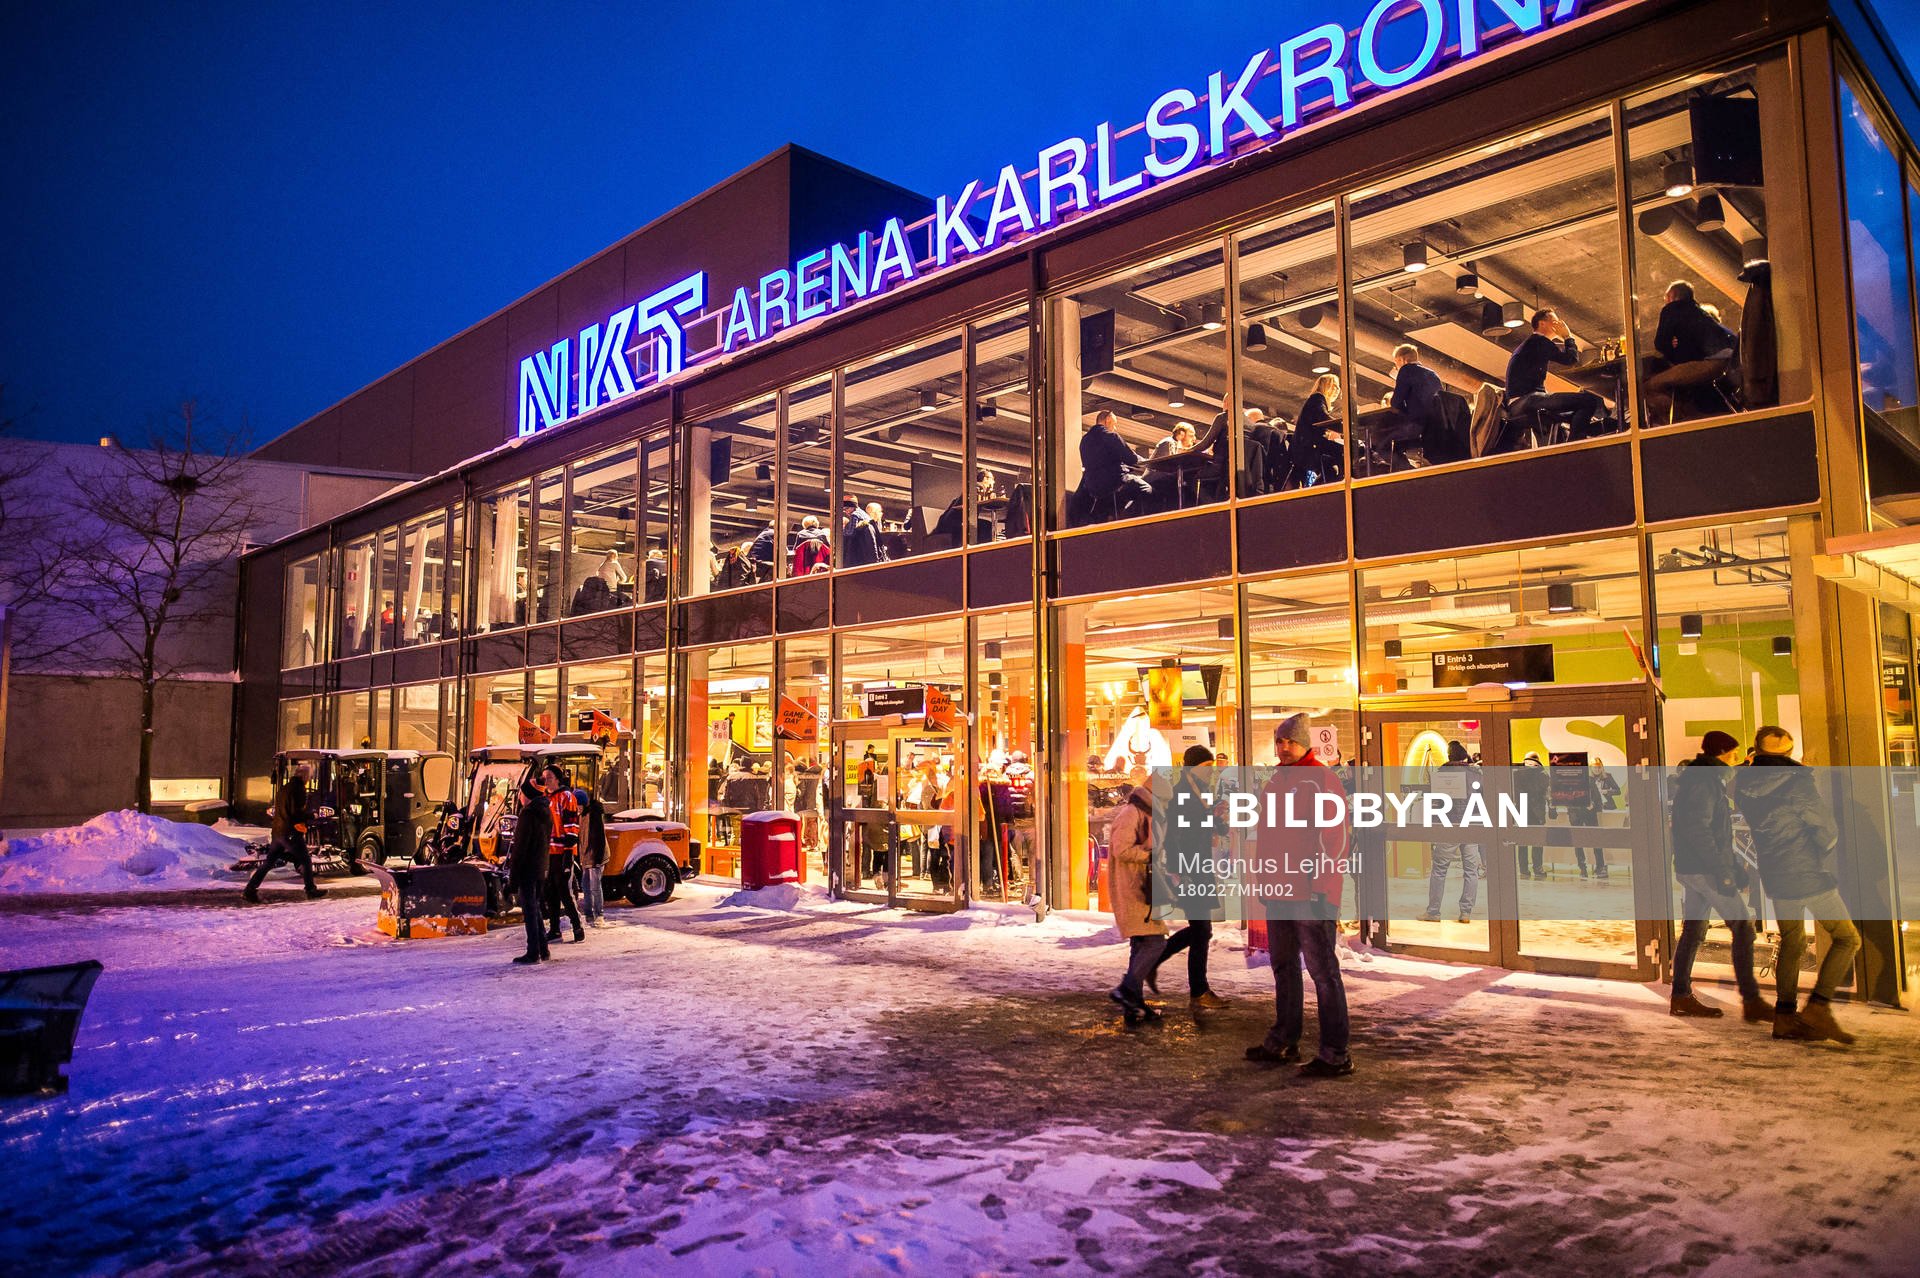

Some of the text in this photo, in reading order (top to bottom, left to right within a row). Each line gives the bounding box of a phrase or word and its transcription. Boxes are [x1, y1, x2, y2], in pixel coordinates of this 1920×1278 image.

[518, 270, 708, 437] NKT
[723, 216, 915, 353] ARENA
[1447, 655, 1467, 663] Entré
[1467, 654, 1473, 662] 3
[930, 697, 952, 705] GAME
[932, 705, 949, 713] DAY
[783, 711, 805, 719] GAME
[784, 717, 801, 725] DAY
